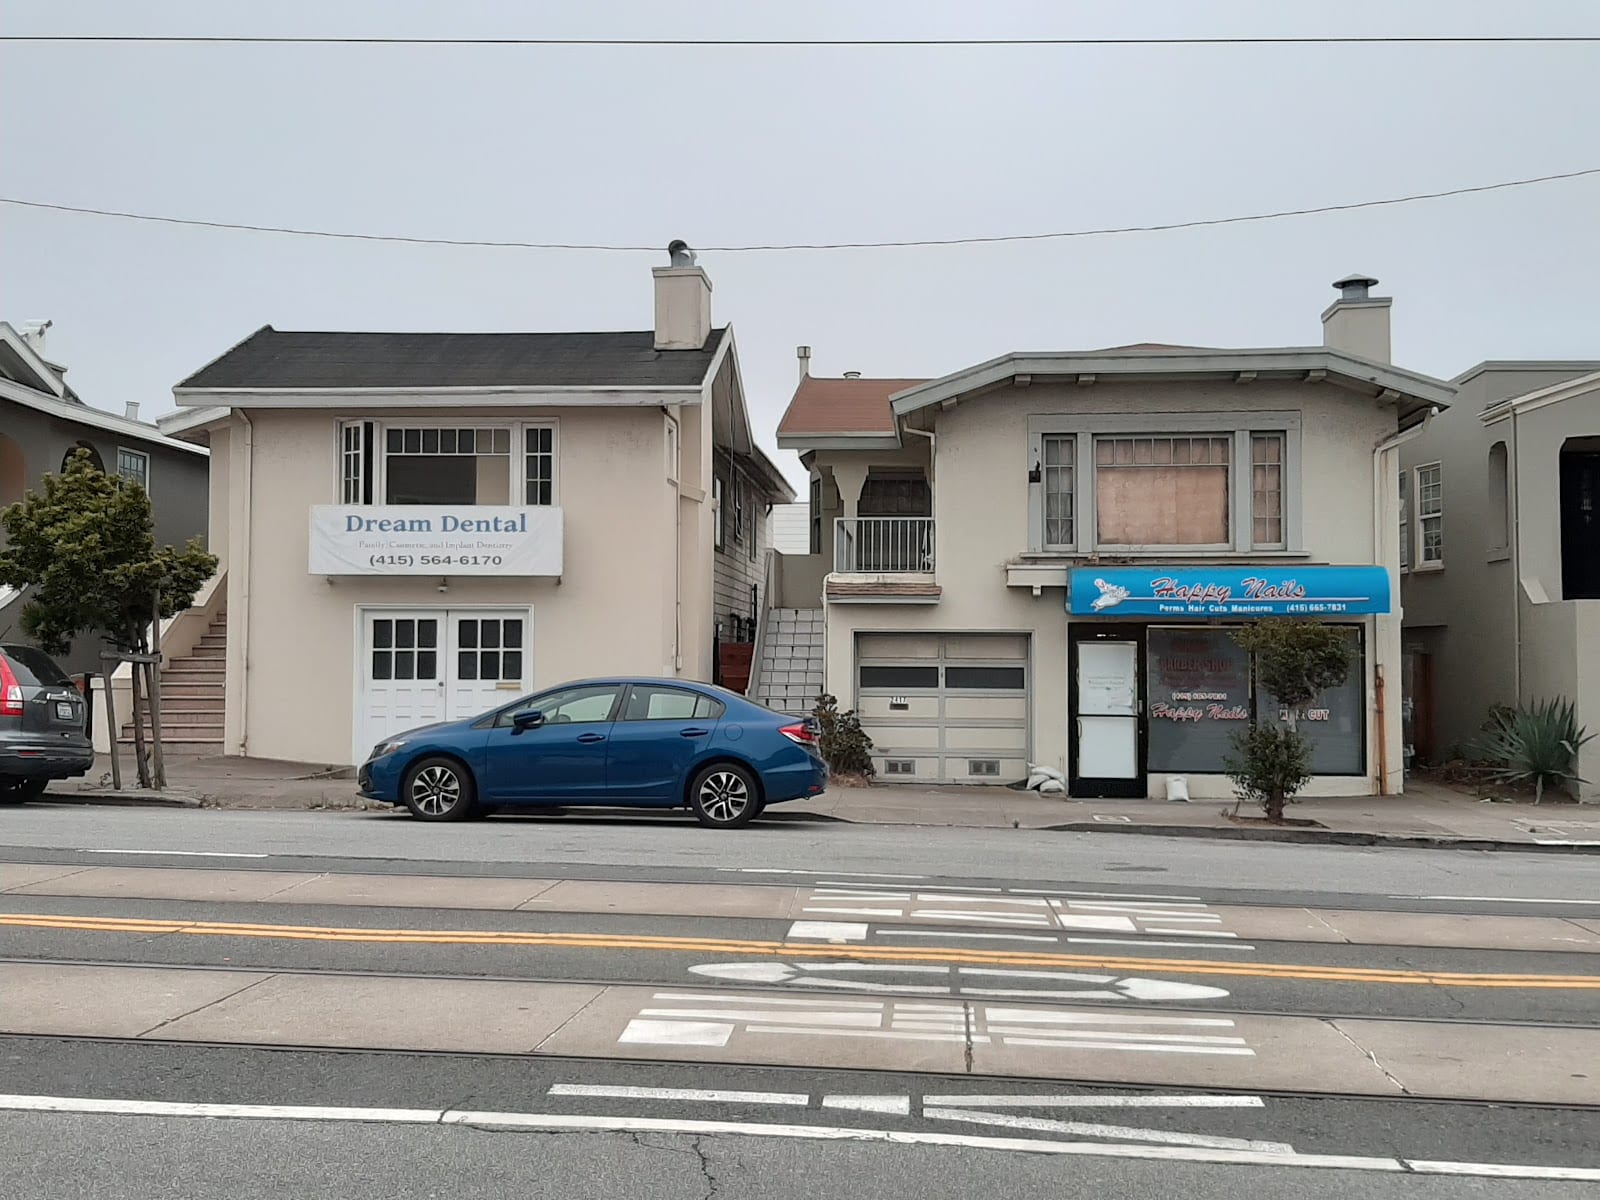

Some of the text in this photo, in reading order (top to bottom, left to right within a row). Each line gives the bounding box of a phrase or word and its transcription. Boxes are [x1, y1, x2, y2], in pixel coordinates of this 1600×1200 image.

[345, 513, 527, 533] Dream Dental
[445, 540, 474, 550] Implant
[369, 554, 503, 567] (415) 564-6170
[1150, 577, 1306, 603] Happy Nails
[1188, 604, 1206, 612] Hair
[1208, 604, 1228, 612] Cuts
[1231, 604, 1273, 613] Manicures
[1286, 603, 1308, 613] (415)
[1150, 702, 1248, 721] Happy Nails
[1308, 709, 1330, 720] CUT
